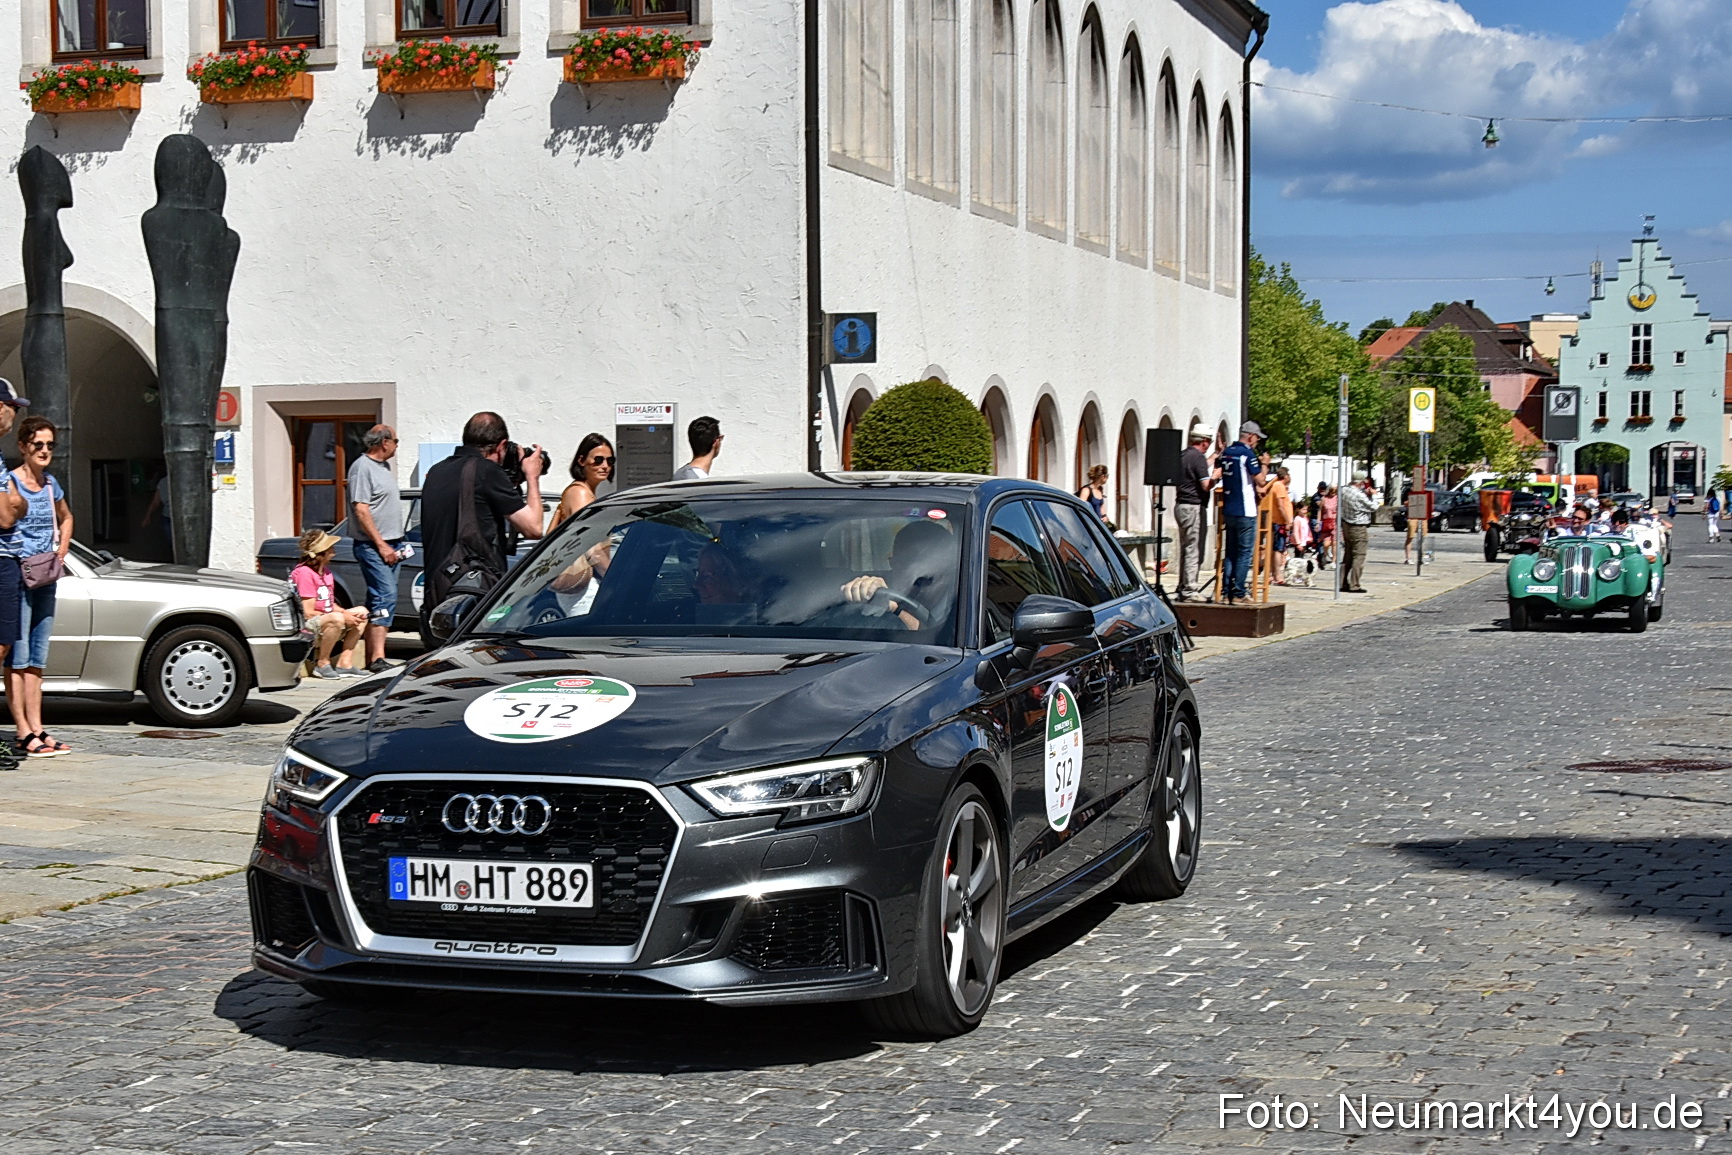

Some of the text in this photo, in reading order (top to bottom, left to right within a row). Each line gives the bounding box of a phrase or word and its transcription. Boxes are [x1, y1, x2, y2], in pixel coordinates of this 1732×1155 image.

[618, 405, 663, 414] NEUMARKT
[502, 703, 578, 719] S12
[1055, 757, 1073, 793] S12
[395, 882, 404, 893] D
[410, 862, 589, 903] HM HT 889
[479, 905, 506, 913] Zentrum
[506, 906, 536, 915] Frankfurt
[434, 941, 558, 956] quattro
